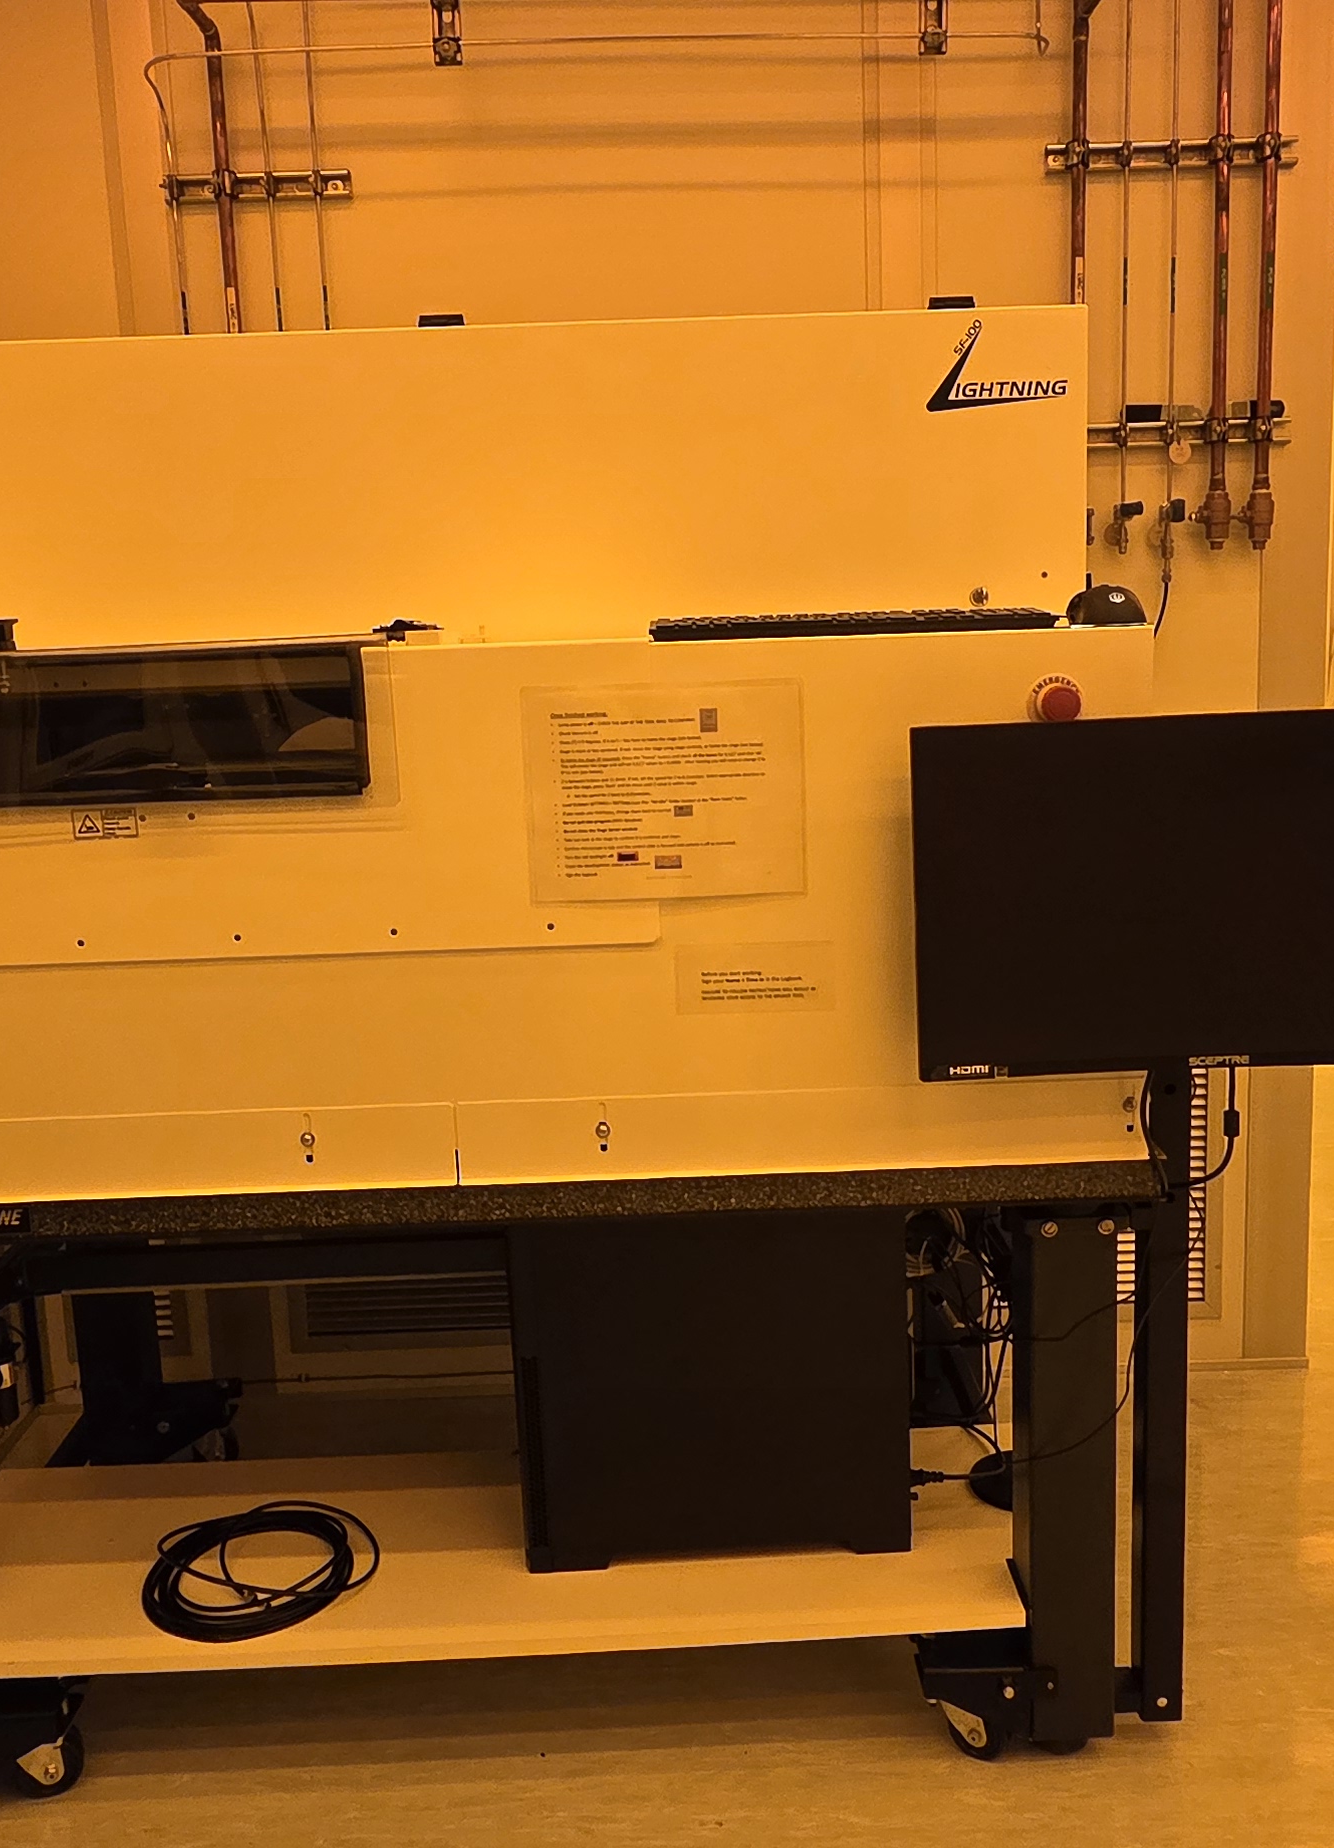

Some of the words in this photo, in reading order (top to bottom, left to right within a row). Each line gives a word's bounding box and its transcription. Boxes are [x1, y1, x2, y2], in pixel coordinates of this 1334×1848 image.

[953, 319, 982, 356] SF-100
[1188, 1055, 1250, 1066] SCEPTRE
[949, 1064, 989, 1076] HDMI
